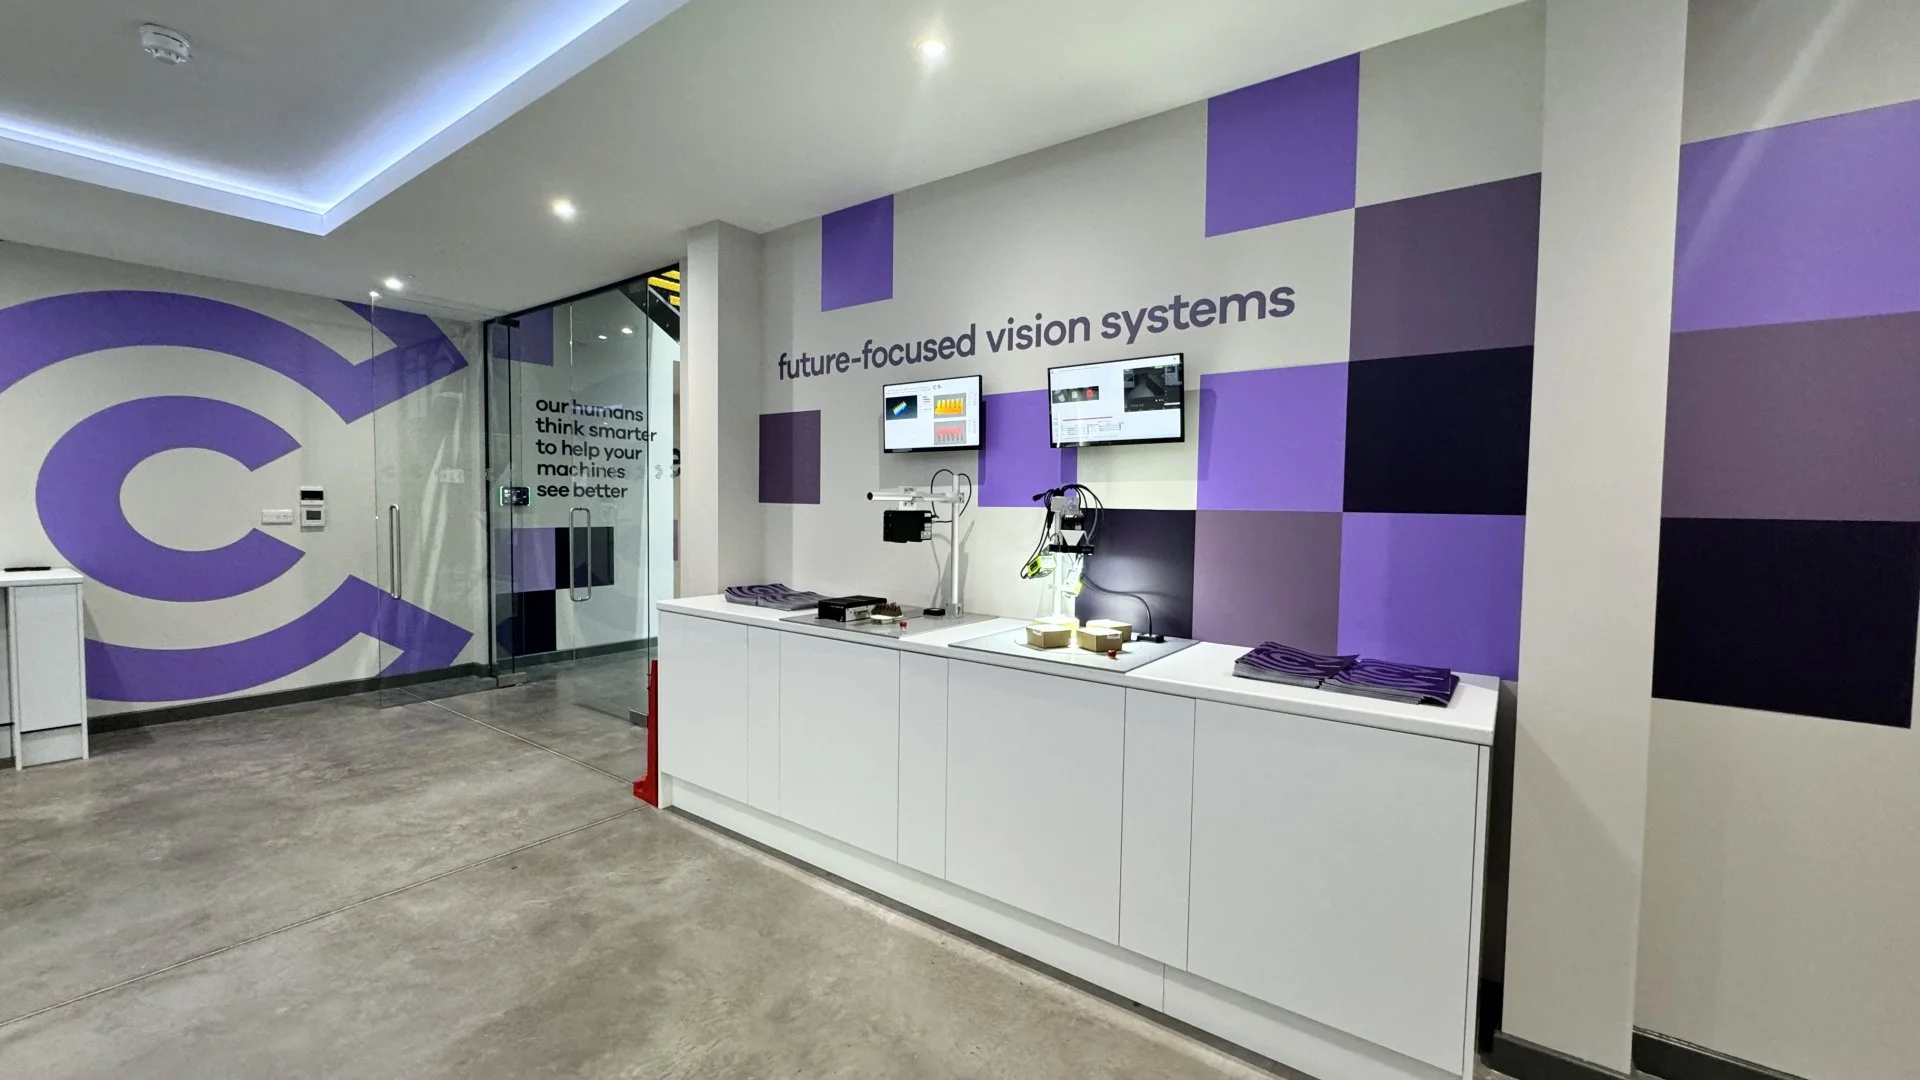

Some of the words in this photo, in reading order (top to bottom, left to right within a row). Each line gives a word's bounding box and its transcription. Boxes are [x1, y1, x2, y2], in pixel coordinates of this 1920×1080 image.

[778, 323, 977, 381] future-focused
[985, 311, 1091, 354] vision
[1100, 285, 1296, 344] systems
[535, 399, 569, 413] our
[572, 399, 644, 422] humans
[535, 417, 585, 436] think
[589, 425, 658, 442] smarter
[535, 439, 557, 455] to
[562, 440, 600, 460] help
[604, 448, 642, 461] your
[537, 462, 626, 479] machines
[537, 485, 570, 497] see
[573, 482, 628, 498] better
